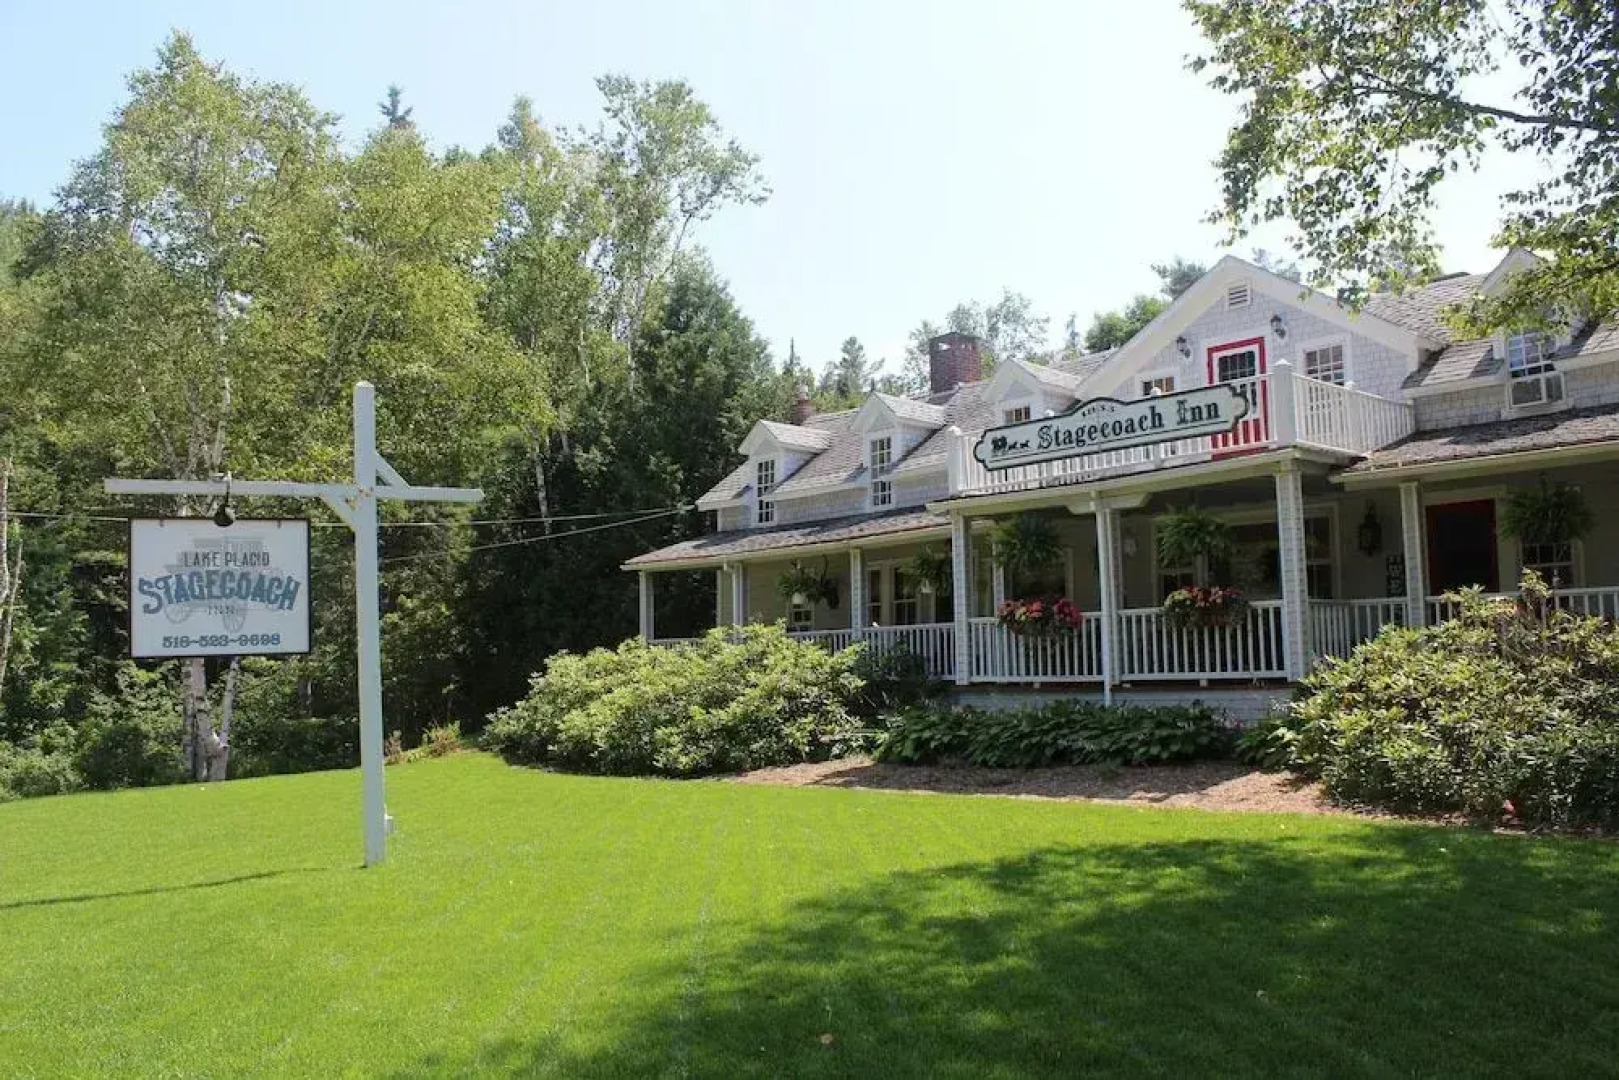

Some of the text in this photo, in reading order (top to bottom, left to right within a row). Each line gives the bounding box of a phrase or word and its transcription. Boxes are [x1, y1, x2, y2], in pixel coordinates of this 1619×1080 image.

[1036, 399, 1220, 450] Stagecoach Inn
[184, 551, 270, 567] LAKE PLACID
[138, 570, 301, 614] STAGECOACH
